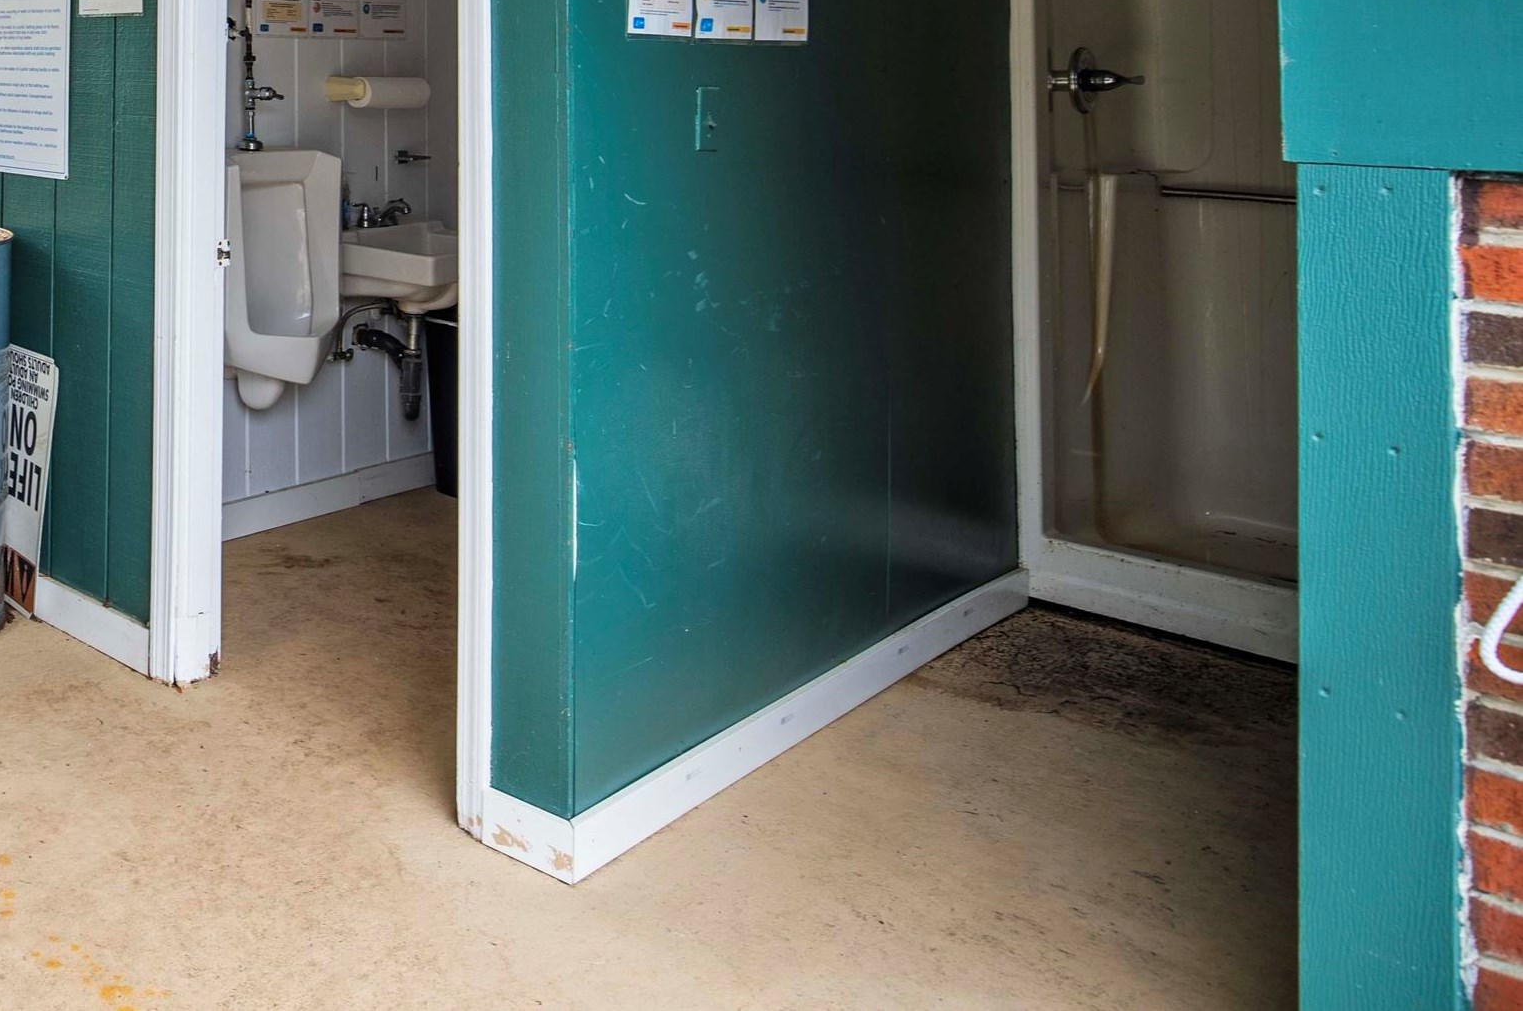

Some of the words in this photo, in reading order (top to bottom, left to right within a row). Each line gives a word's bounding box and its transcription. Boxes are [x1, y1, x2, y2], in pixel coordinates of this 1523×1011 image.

[28, 356, 51, 376] ADULTS
[29, 369, 39, 384] AN
[10, 387, 39, 410] CHILDREN
[17, 377, 49, 401] SWIMMING
[10, 403, 37, 456] ON
